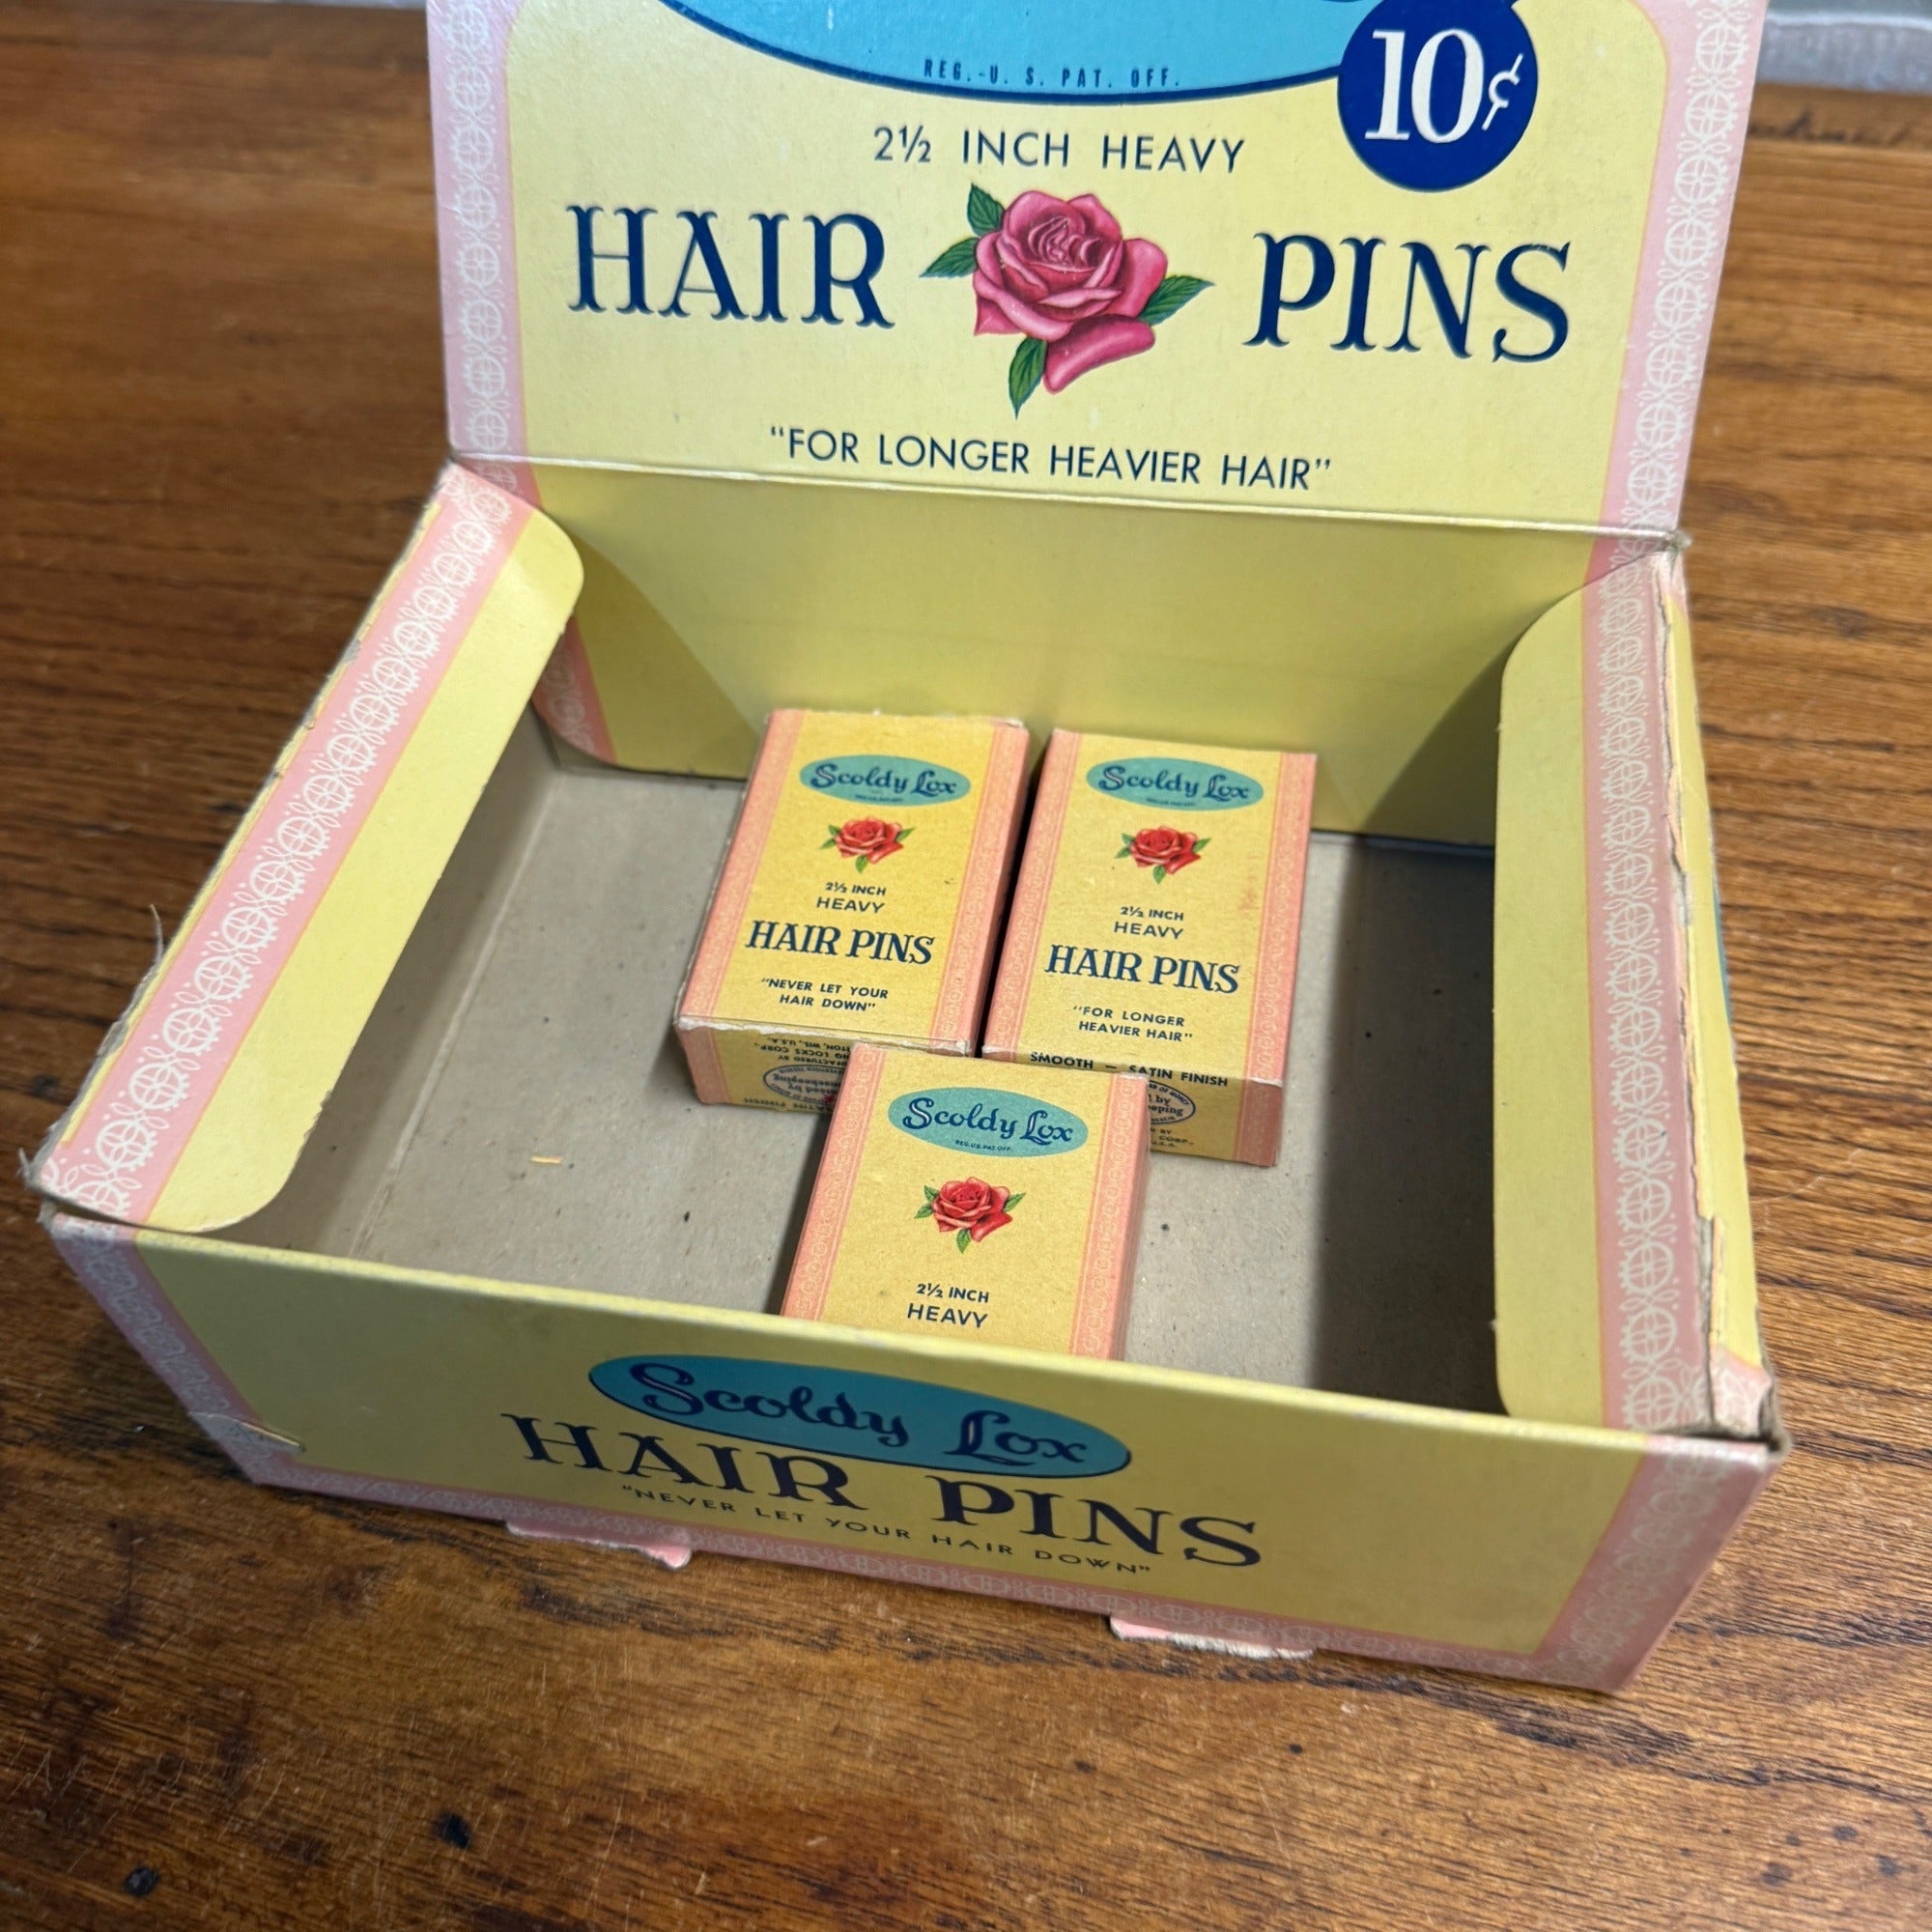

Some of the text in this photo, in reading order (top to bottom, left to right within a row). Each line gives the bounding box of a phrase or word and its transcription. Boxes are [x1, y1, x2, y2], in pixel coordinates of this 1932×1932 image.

[1026, 67, 1044, 86] S.
[1063, 69, 1113, 88] PAT.
[1131, 68, 1180, 87] OFF.
[1365, 28, 1523, 143] 10¢
[874, 126, 1245, 174] 2½ INCH HEAVY
[567, 205, 1571, 363] HAIR PINS
[771, 427, 1331, 491] "FOR LONGER HEAVIER HAIR"
[810, 762, 956, 796] Scoldy Lox
[1098, 765, 1249, 802] Scoldy Lox
[852, 884, 887, 896] INCH
[816, 896, 885, 914] HEAVY
[1148, 908, 1184, 922] INCH
[746, 921, 934, 964] HAIR PINS
[1114, 921, 1183, 940] HEAVY
[1044, 944, 1240, 994] HAIR PINS
[761, 977, 888, 1000] "NEVER LET YOUR
[780, 994, 876, 1011] HAIR DOWN"
[1073, 1005, 1184, 1027] "FOR LONGER
[1079, 1020, 1193, 1042] HEAVIER HAIR"
[795, 1048, 829, 1058] LOCKS
[1030, 1051, 1094, 1069] SMOOTH
[1129, 1065, 1173, 1080] SATIN
[1180, 1072, 1228, 1087] FINISH
[1155, 1094, 1171, 1107] by
[901, 1096, 1074, 1147] Scoldy Lox
[916, 1283, 990, 1304] 2½ INCH
[906, 1303, 988, 1328] HEAVY
[630, 1361, 1086, 1466] Scoldy Lox
[500, 1413, 1262, 1568] HAIR PINS
[621, 1485, 1151, 1575] "NEVER LET YOUR HAIR DOWN"
